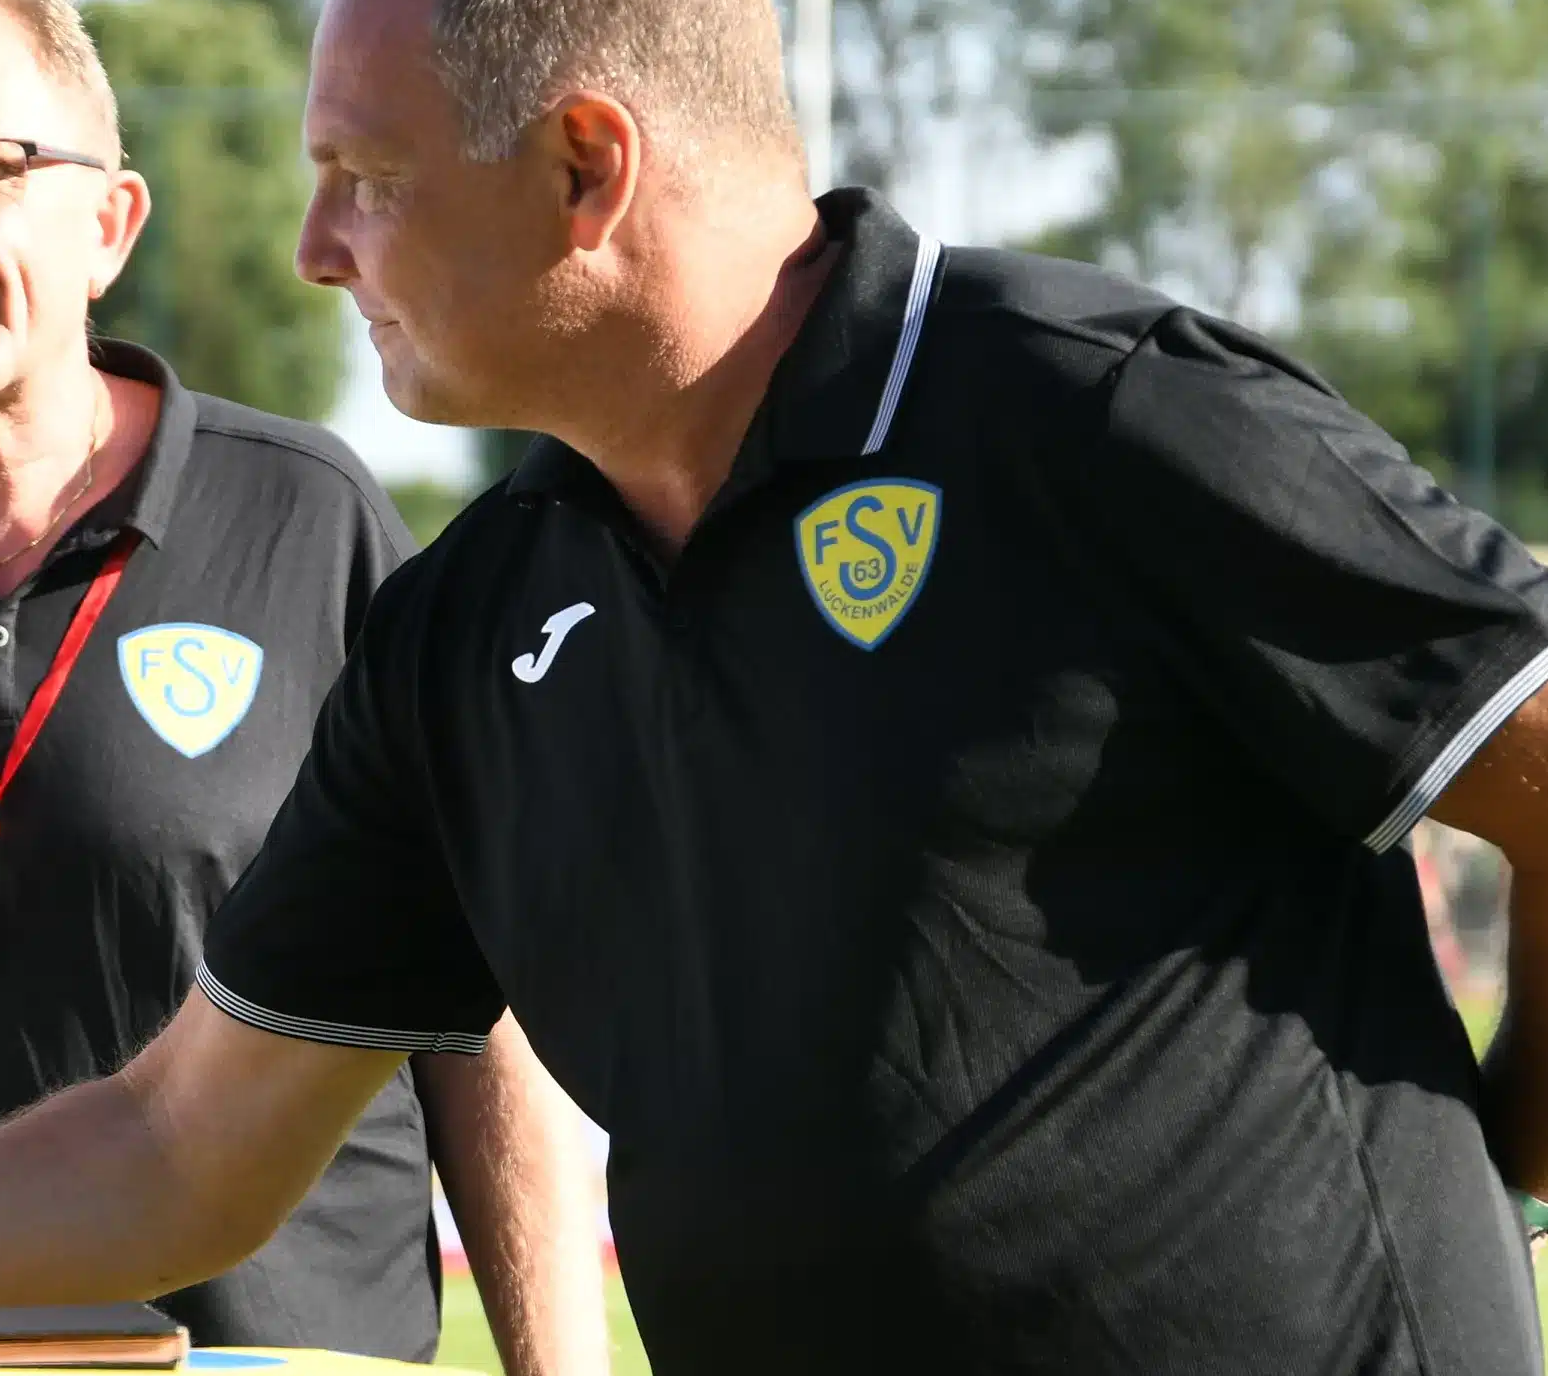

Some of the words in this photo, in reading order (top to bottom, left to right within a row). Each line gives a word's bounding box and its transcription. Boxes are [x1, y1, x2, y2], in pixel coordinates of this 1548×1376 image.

[815, 495, 926, 601] FSV
[854, 558, 881, 582] 63
[819, 562, 919, 620] LUCKENWALDE
[140, 638, 244, 717] FSV
